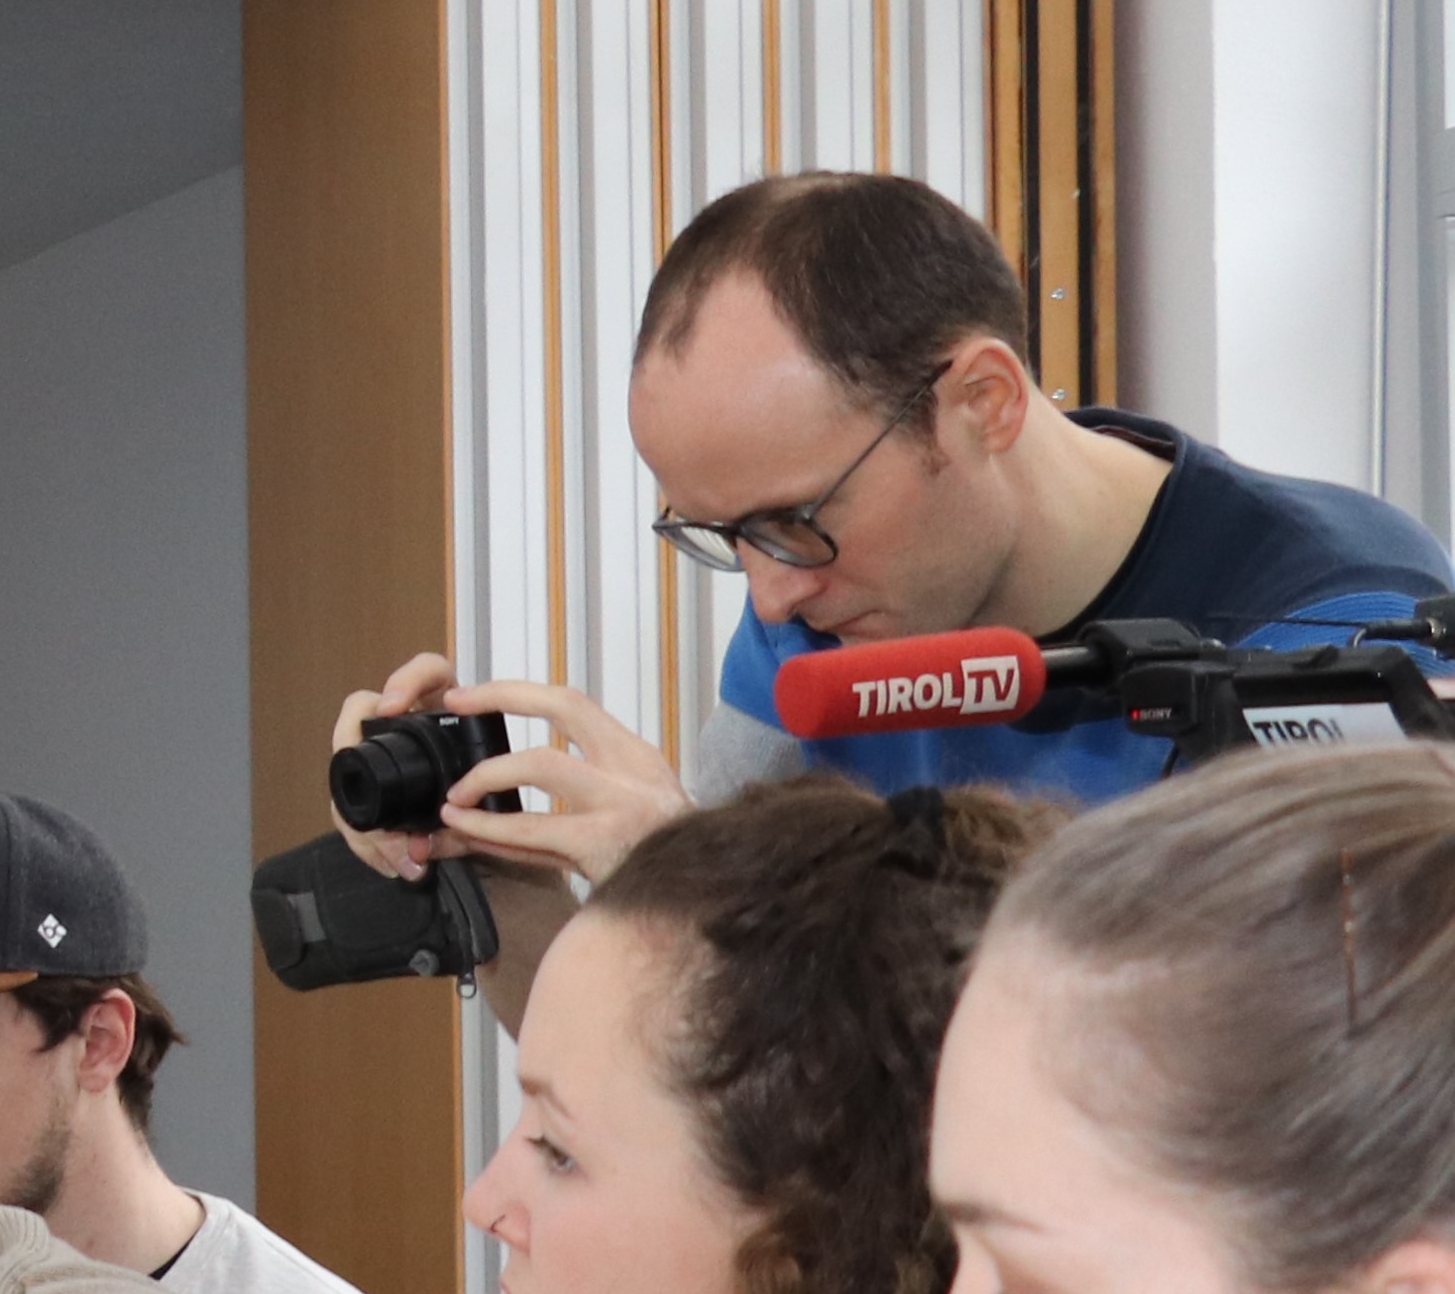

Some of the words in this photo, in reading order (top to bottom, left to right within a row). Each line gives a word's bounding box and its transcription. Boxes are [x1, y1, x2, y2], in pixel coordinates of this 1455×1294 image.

[851, 672, 963, 718] TIROL
[967, 668, 1015, 703] TV
[1139, 707, 1172, 721] SONY
